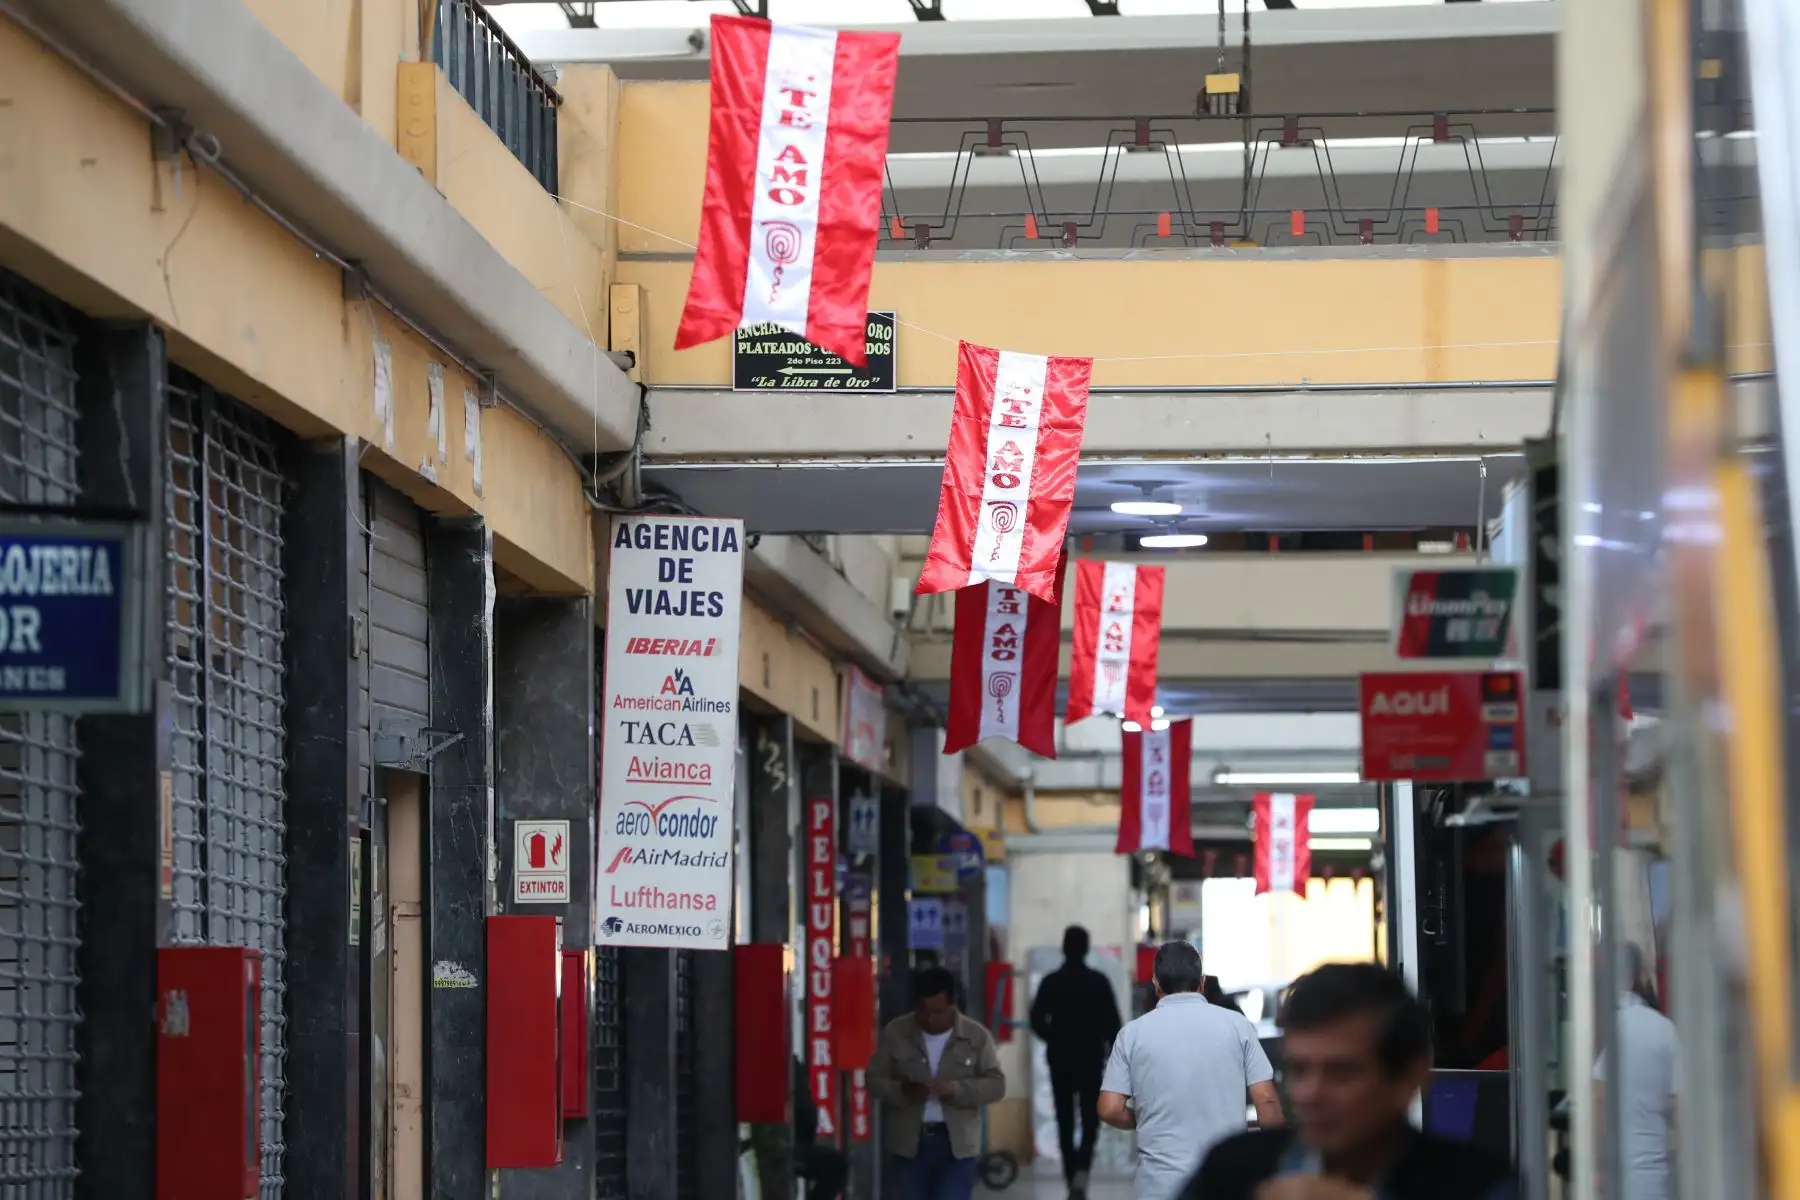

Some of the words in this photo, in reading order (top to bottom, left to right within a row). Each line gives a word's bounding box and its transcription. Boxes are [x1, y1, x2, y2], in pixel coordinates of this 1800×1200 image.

[768, 144, 808, 206] AMO
[867, 322, 893, 341] ORO
[738, 342, 811, 355] PLATEADOS
[787, 357, 803, 365] 2do
[805, 357, 824, 365] Piso
[825, 357, 842, 365] 223
[781, 376, 818, 387] Libra
[824, 376, 841, 387] de
[998, 397, 1032, 428] TE
[991, 440, 1025, 489] AMO
[614, 523, 739, 553] AGENCIA
[658, 557, 694, 584] DE
[625, 588, 724, 618] VIAJES
[625, 637, 703, 656] IBERIA
[0, 667, 66, 692] NES
[620, 720, 697, 747] TACA
[627, 756, 712, 781] Avianca
[519, 881, 565, 894] EXTINTOR
[610, 884, 717, 911] Lufthansa
[812, 802, 834, 1134] PELUQUERIA
